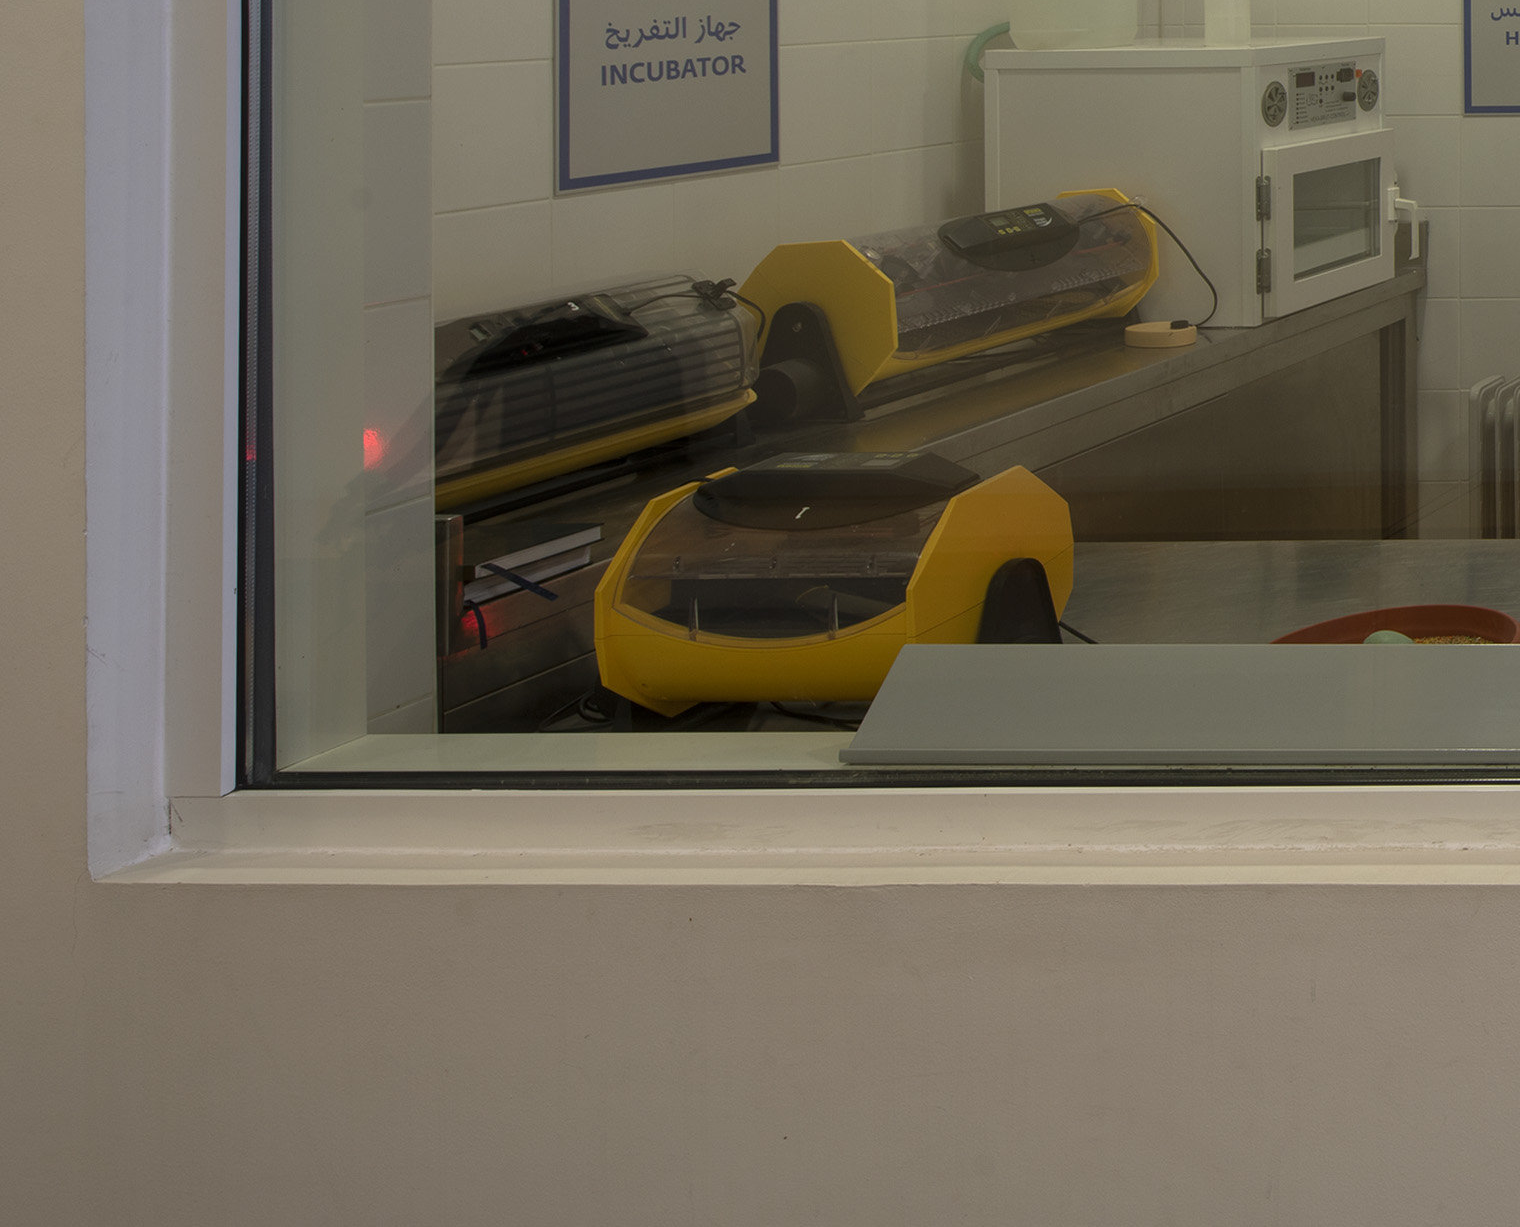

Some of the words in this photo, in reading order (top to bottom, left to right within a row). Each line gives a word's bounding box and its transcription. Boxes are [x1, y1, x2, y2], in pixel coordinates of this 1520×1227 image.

[605, 17, 686, 49] التفريخ
[695, 15, 740, 43] جهاز
[601, 55, 746, 86] INCUBATOR
